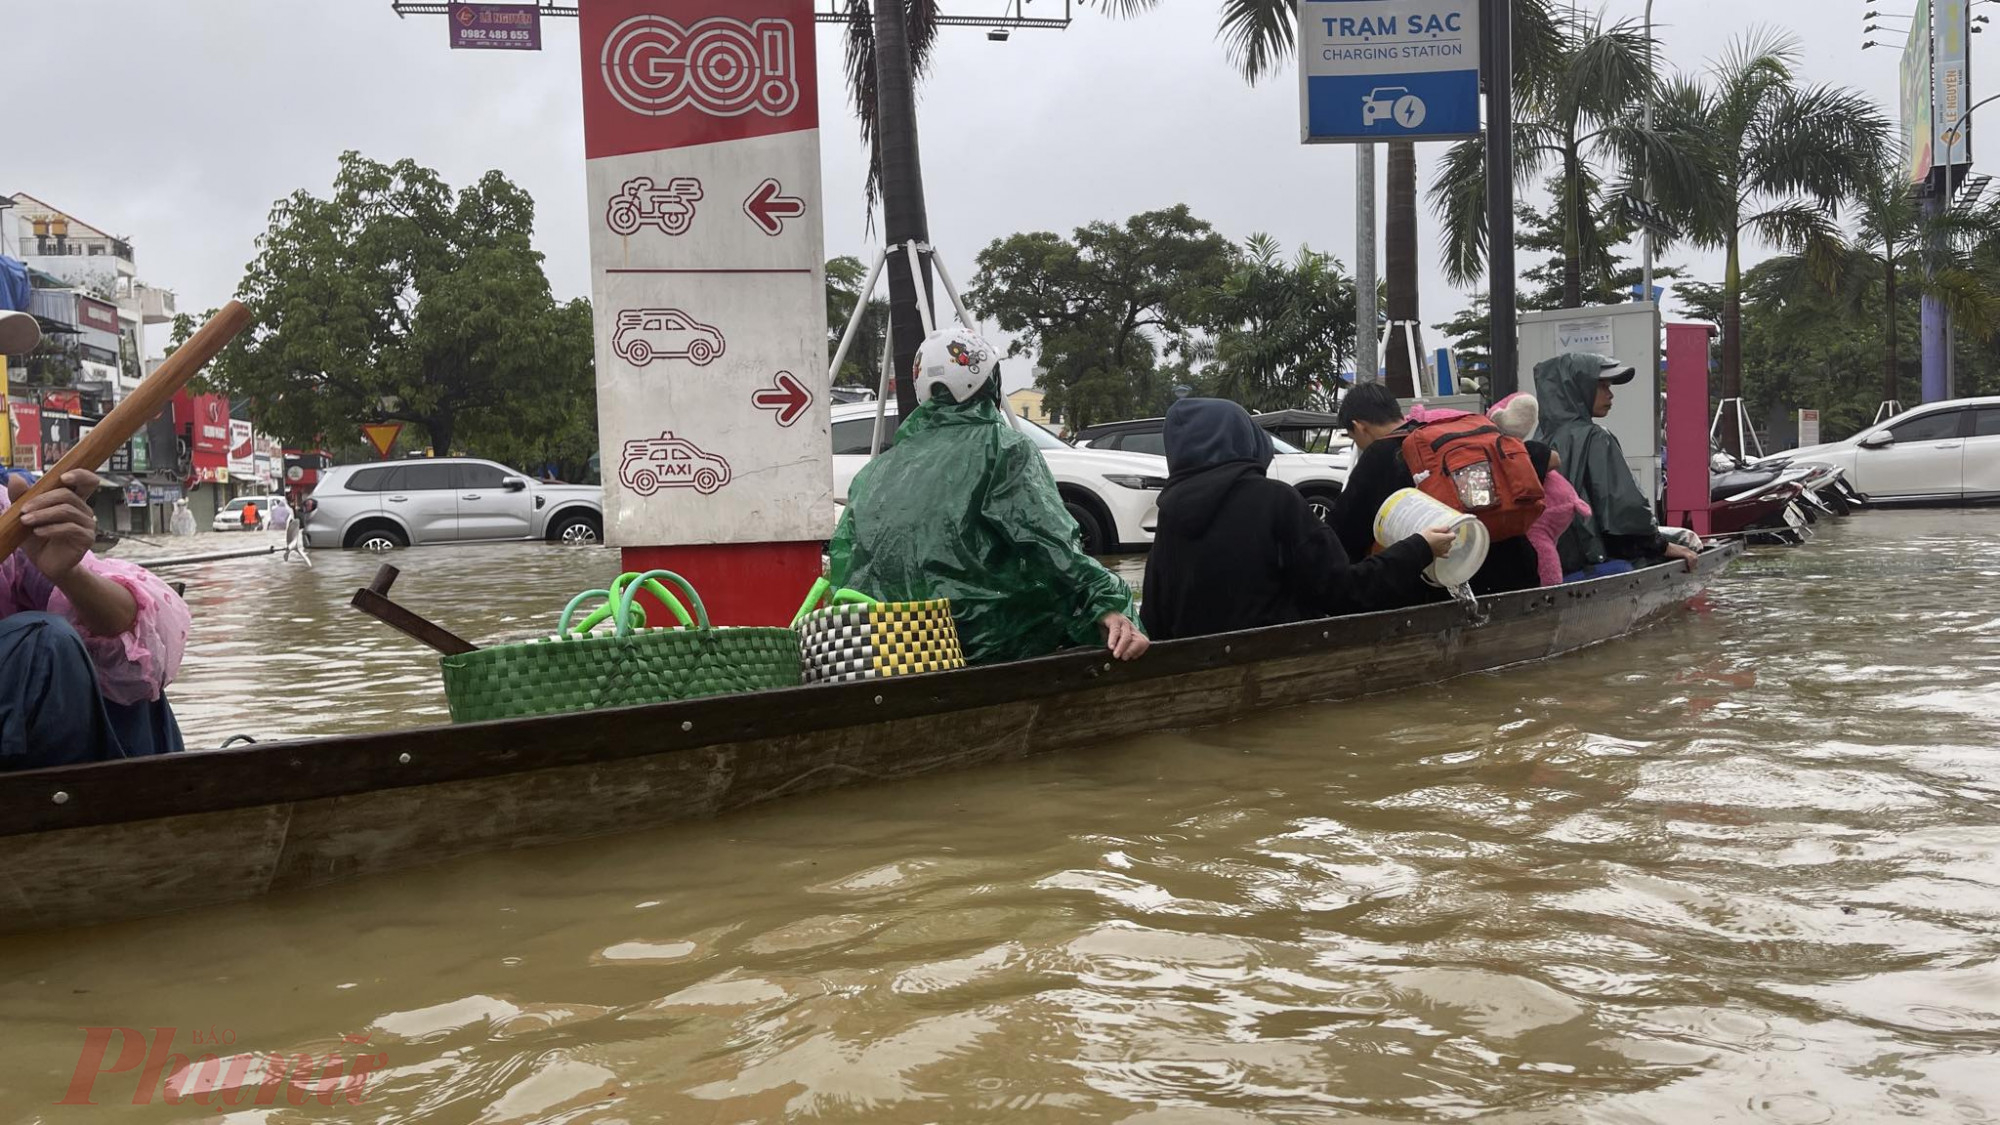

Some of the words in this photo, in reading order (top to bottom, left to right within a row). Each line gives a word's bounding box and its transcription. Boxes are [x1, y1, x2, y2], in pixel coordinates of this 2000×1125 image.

[460, 29, 487, 39] 0982
[488, 30, 508, 39] 488
[1322, 16, 1397, 42] TRẠM
[1407, 12, 1462, 38] SẠC
[1323, 47, 1398, 61] CHARGING
[1402, 43, 1462, 59] STATION
[601, 15, 799, 117] GO!
[655, 463, 692, 476] TAXI
